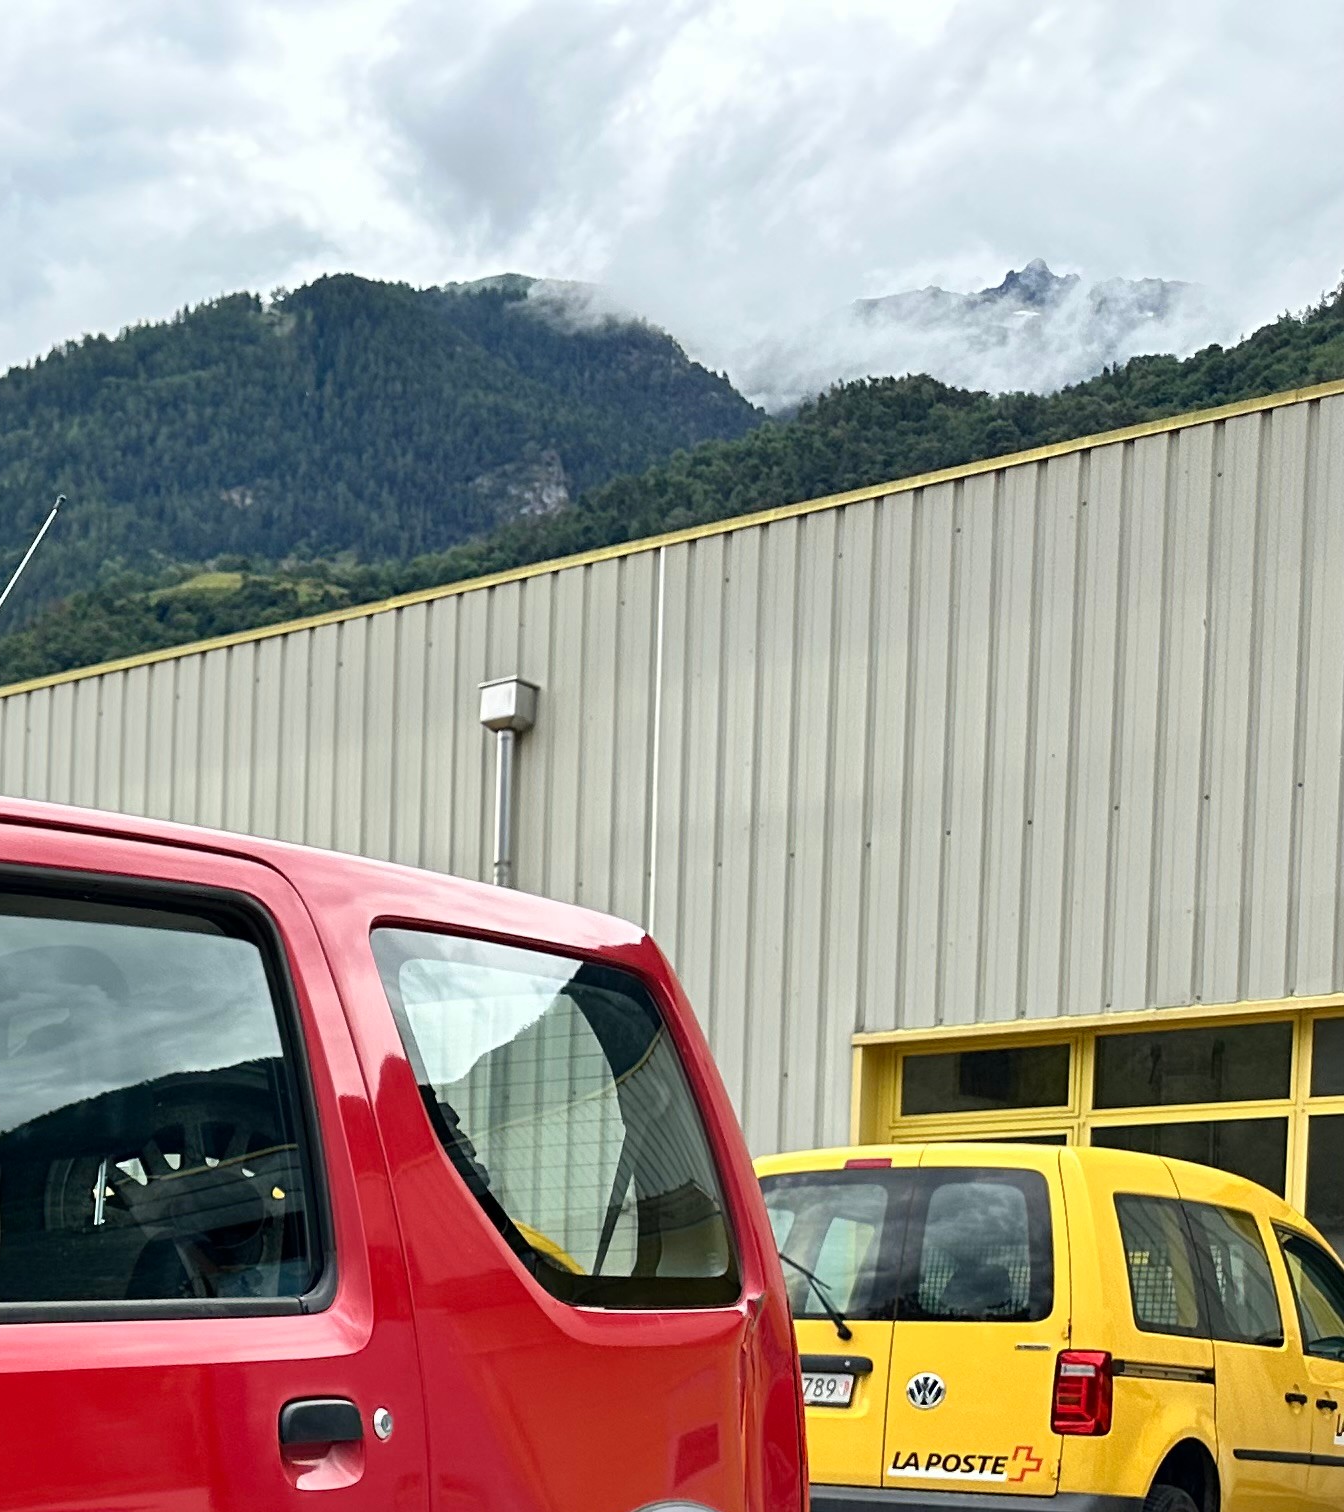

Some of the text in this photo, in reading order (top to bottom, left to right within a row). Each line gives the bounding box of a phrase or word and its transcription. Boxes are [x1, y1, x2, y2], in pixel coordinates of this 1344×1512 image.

[803, 1377, 837, 1399] 789
[892, 1451, 1009, 1475] LA POSTE
